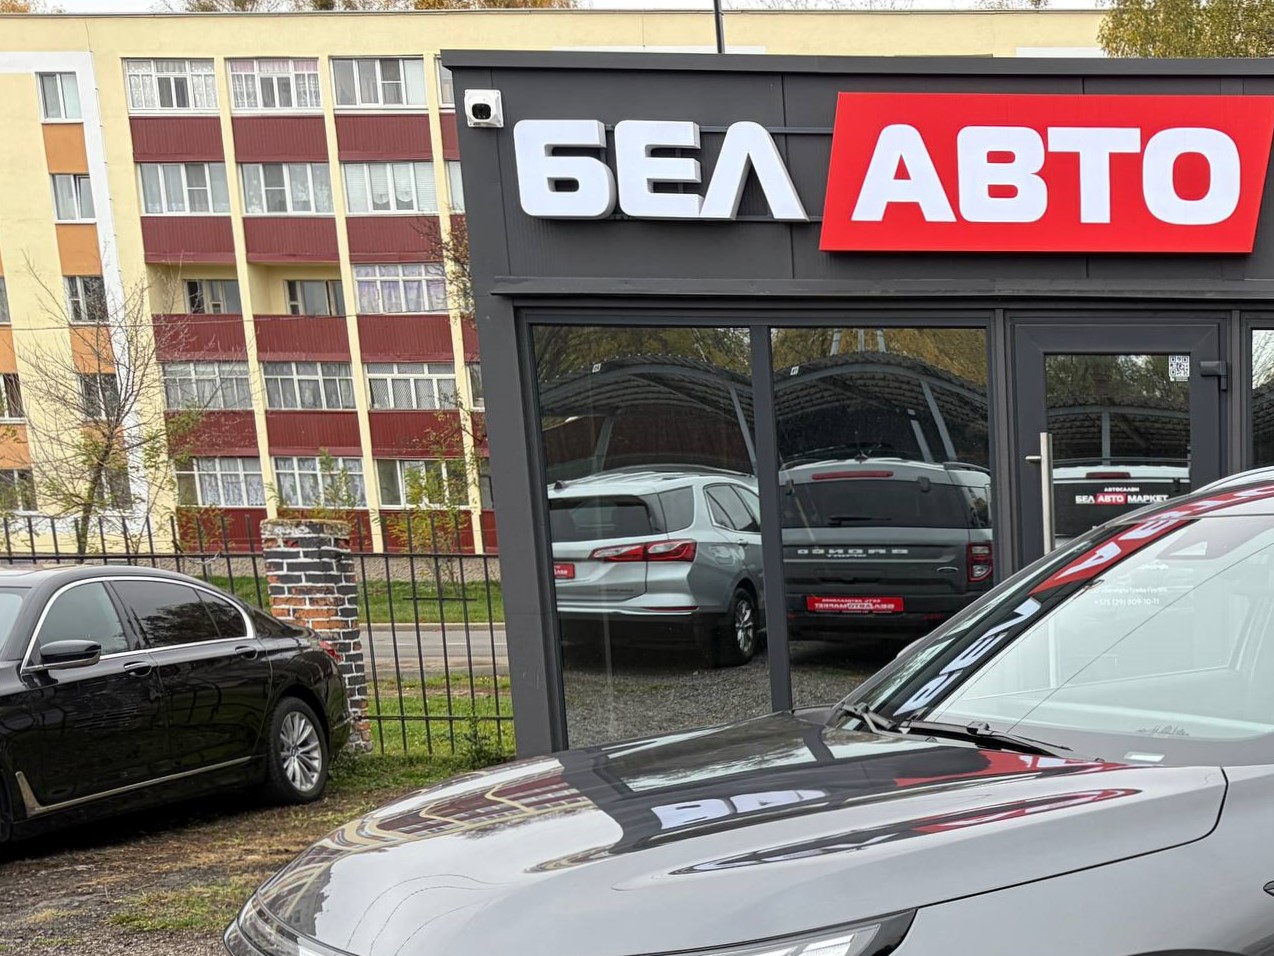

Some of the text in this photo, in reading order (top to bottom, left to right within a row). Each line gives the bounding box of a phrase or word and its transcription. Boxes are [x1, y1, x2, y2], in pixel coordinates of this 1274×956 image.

[513, 118, 809, 223] БЕЛ
[851, 123, 1242, 226] АВТО
[1075, 494, 1169, 504] БЕЛ АВТО МАРКЕТ
